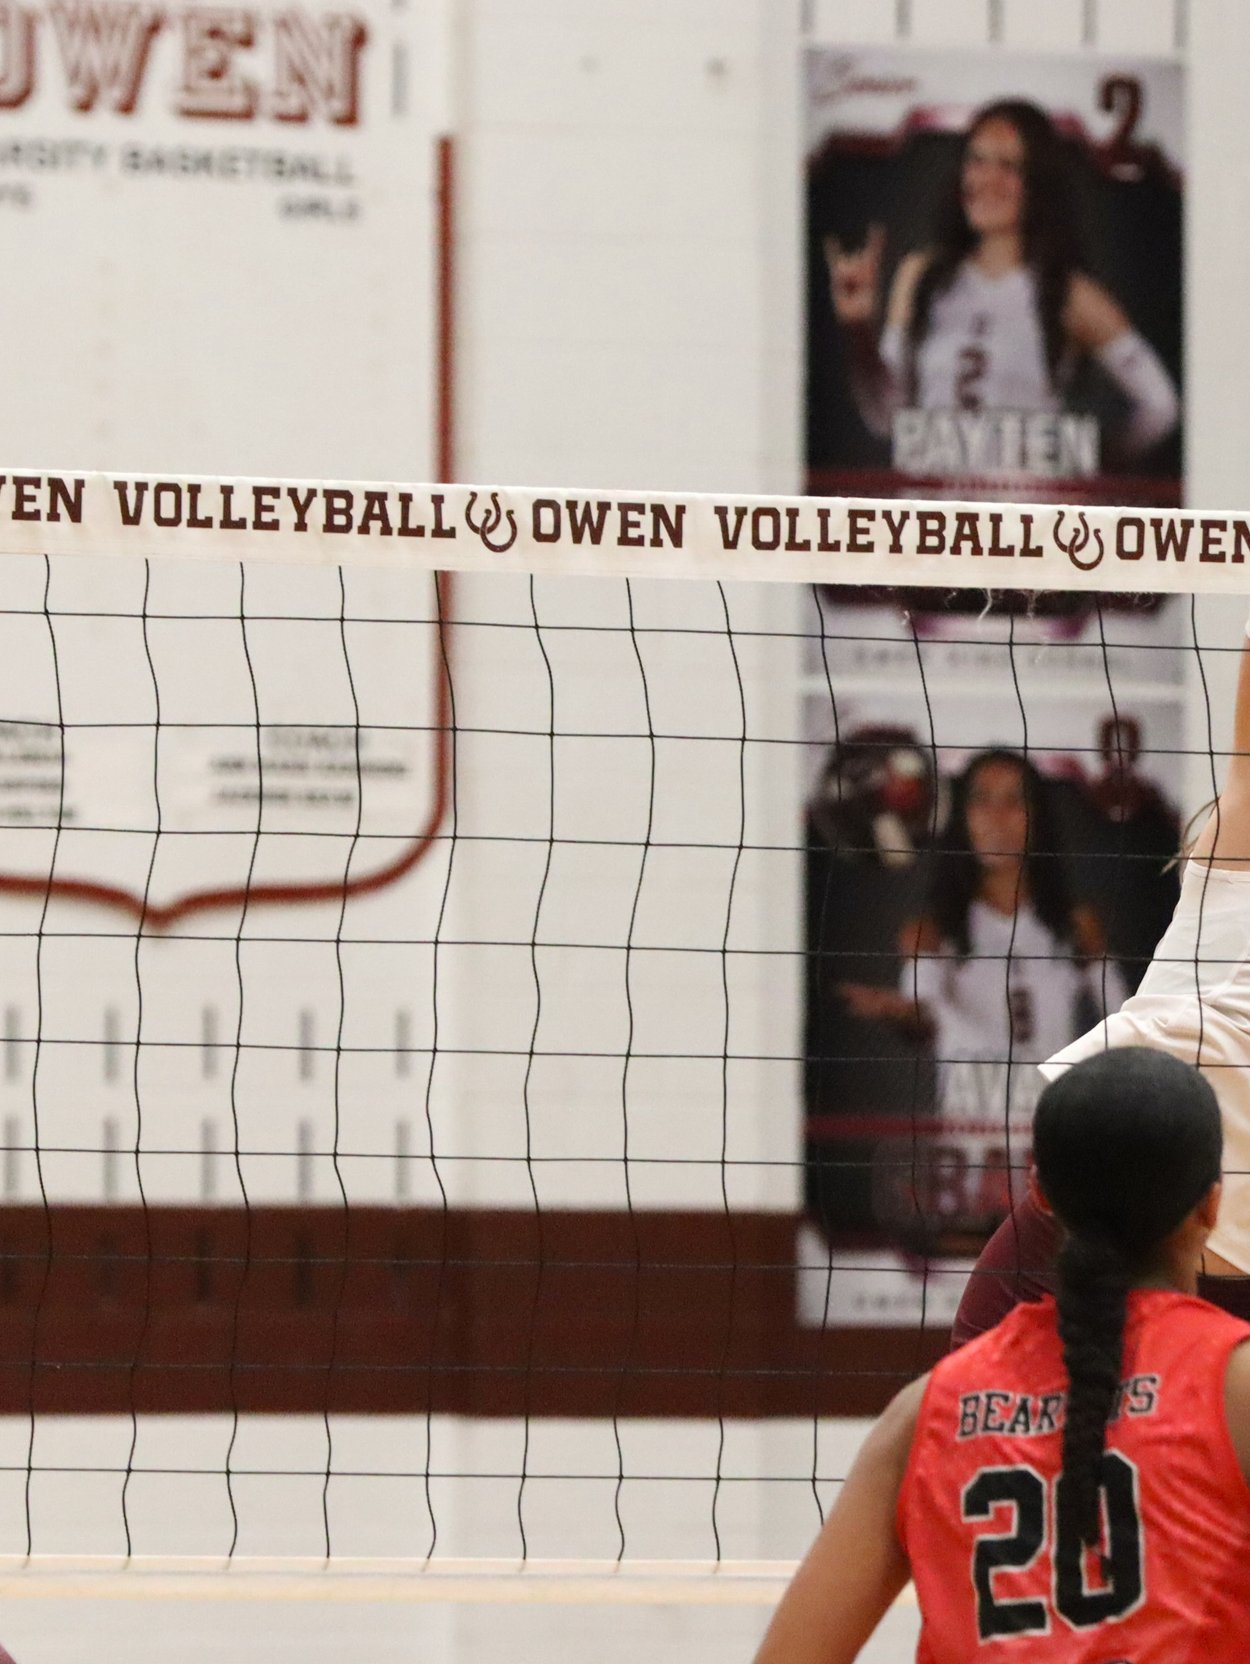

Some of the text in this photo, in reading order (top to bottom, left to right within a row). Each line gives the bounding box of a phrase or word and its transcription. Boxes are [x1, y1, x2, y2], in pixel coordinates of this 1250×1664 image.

[0, 474, 457, 539] EN VOLLEYBALL
[532, 498, 1044, 558] OWEN VOLLEYBALL
[956, 1372, 1162, 1443] BEARTS
[961, 1447, 1147, 1646] 20
